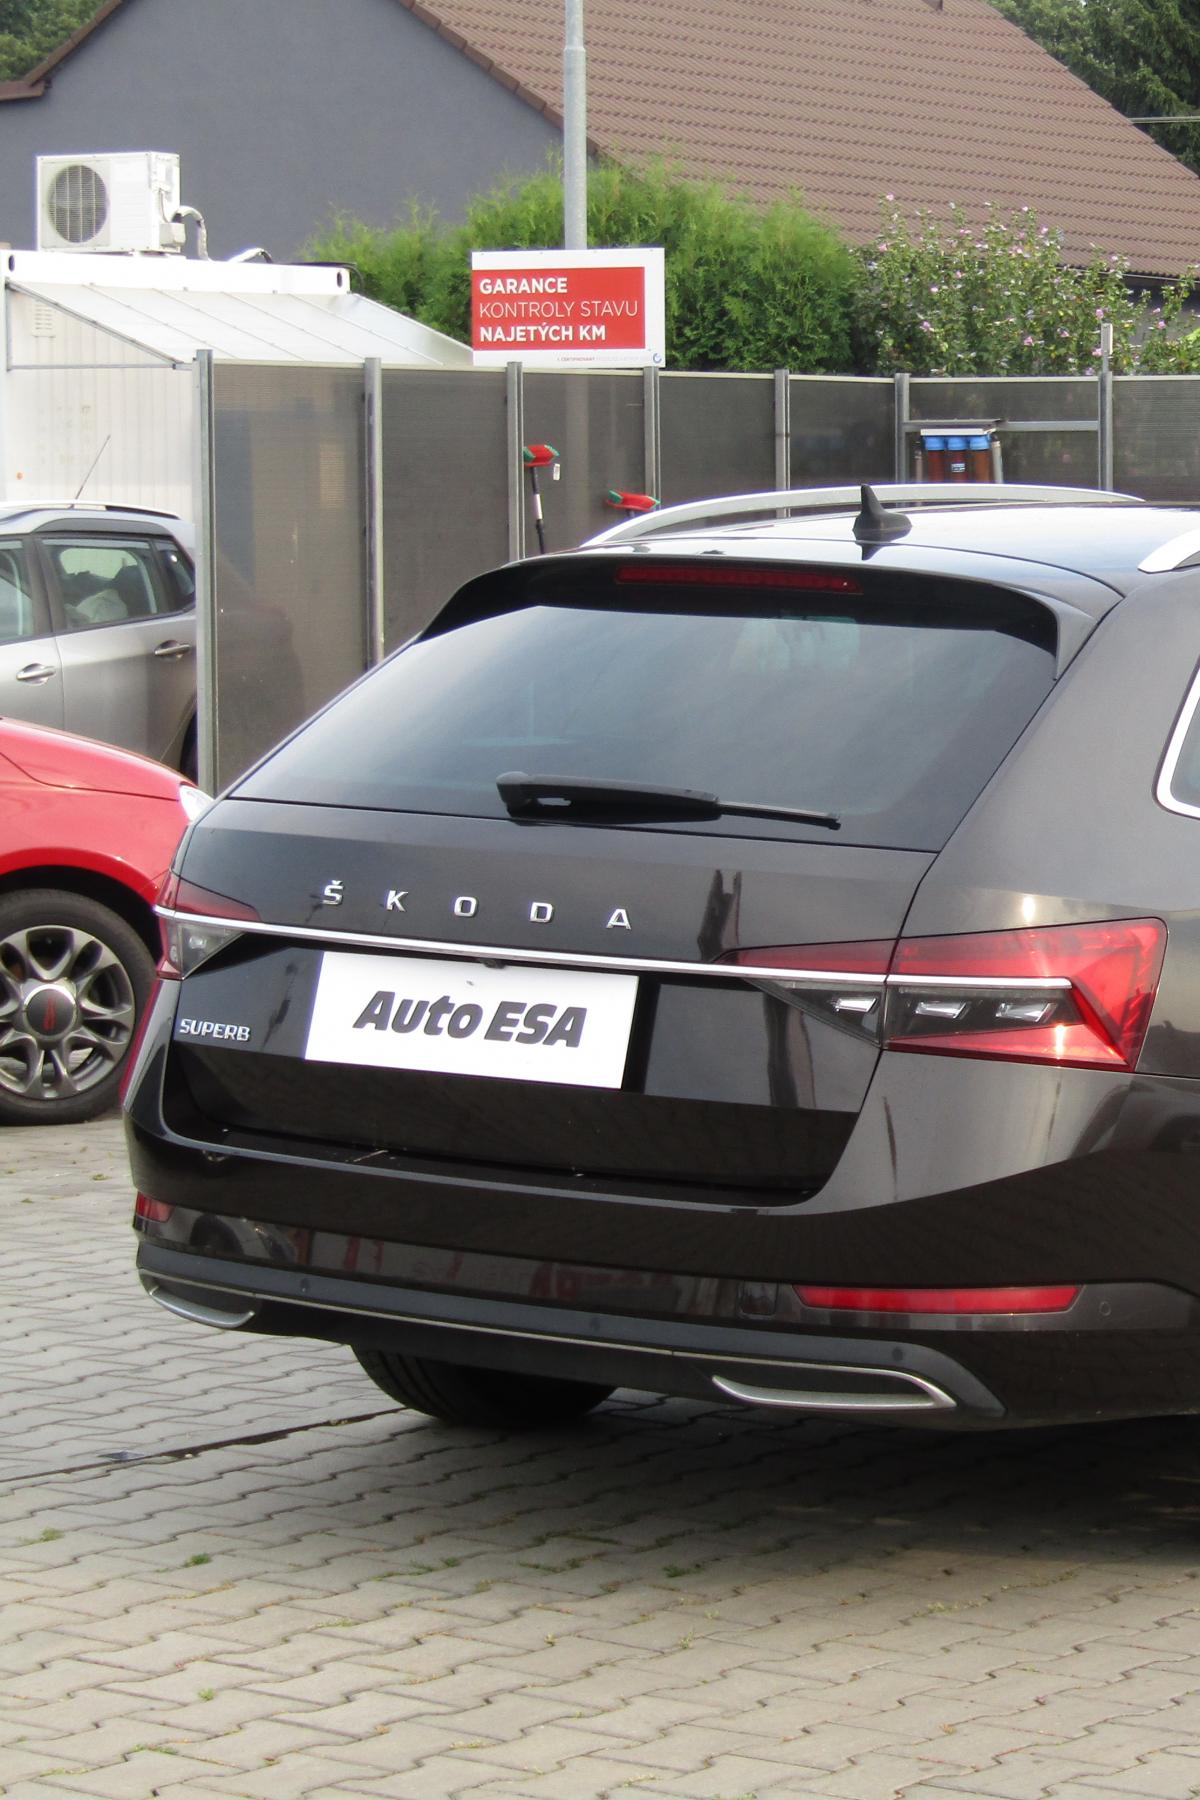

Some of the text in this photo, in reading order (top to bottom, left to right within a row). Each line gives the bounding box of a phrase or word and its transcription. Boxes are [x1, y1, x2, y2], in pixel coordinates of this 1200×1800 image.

[479, 277, 568, 294] GARANCE
[479, 300, 638, 318] KONTROLY STAVU
[480, 322, 606, 342] NAJETÝCH KM
[322, 880, 632, 931] ŠKODA
[352, 989, 588, 1048] Auto ESA
[179, 1018, 251, 1042] SUPERB
